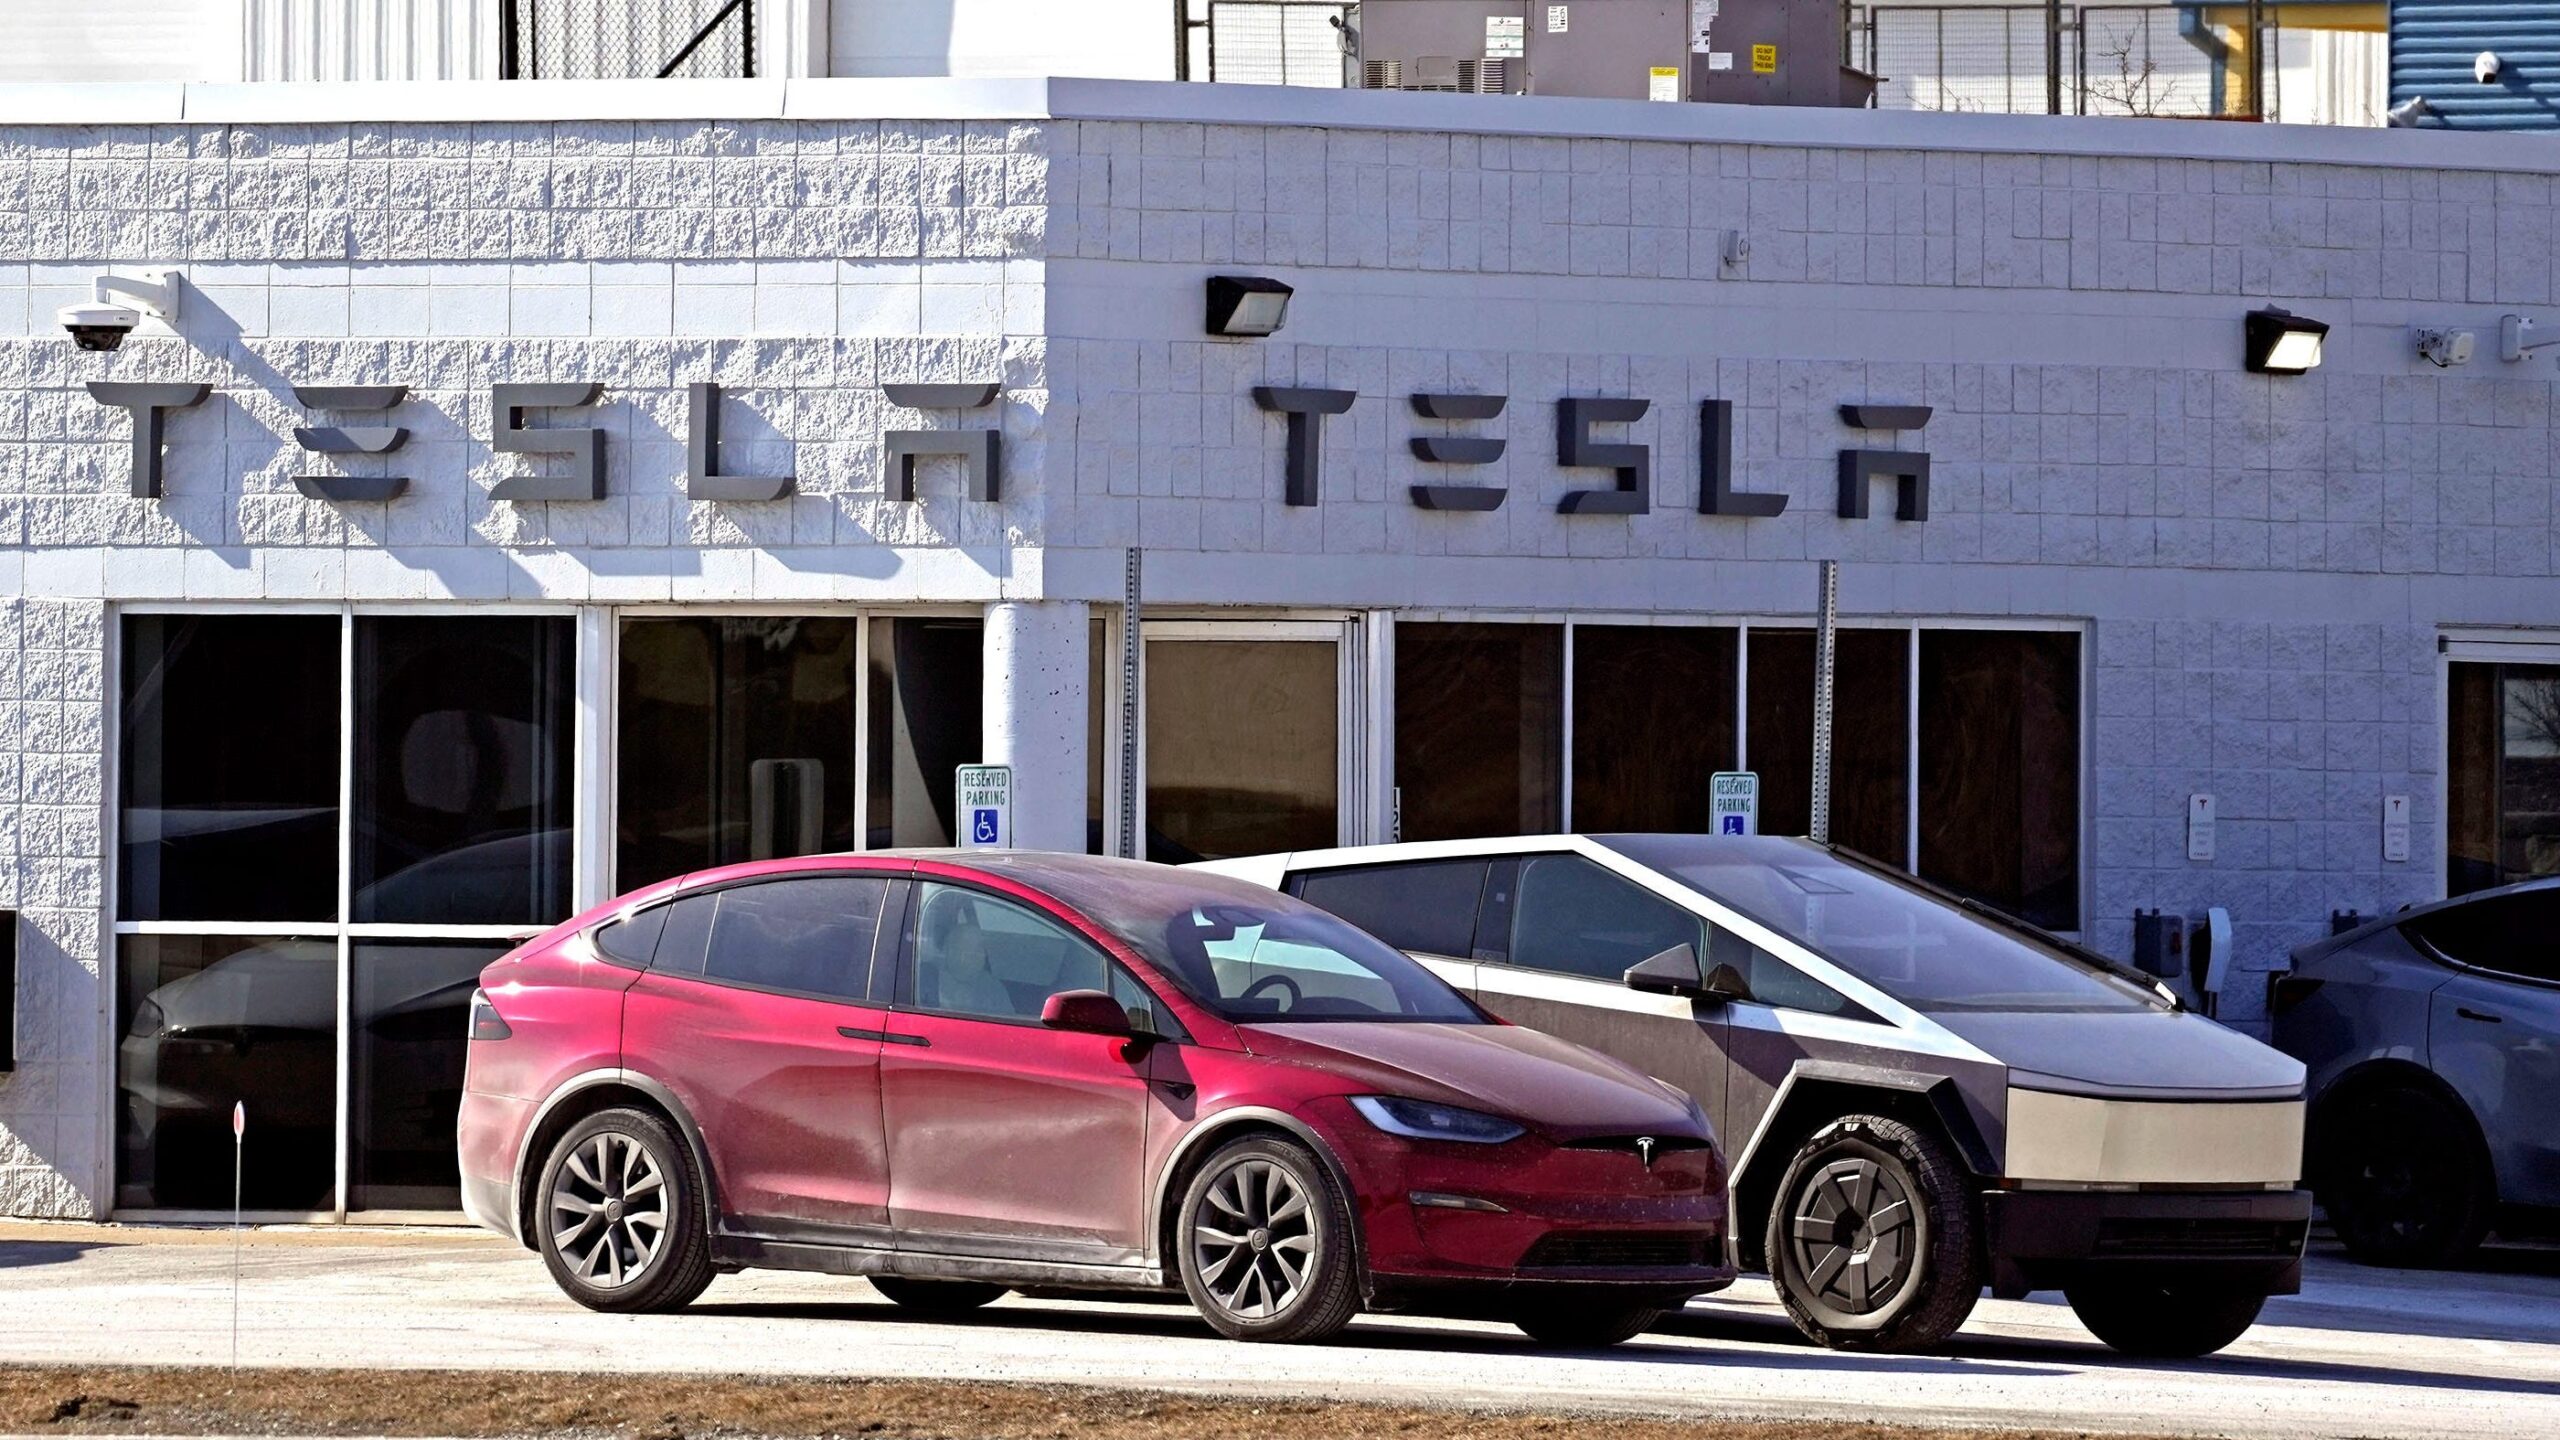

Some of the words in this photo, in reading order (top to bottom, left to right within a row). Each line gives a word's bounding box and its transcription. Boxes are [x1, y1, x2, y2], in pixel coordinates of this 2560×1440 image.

[86, 382, 1000, 503] TESLA
[1252, 386, 1933, 522] TESLA
[964, 772, 1007, 787] RESERVED
[1716, 780, 1753, 795] RESERVED
[966, 791, 1006, 806] PARKING
[1717, 798, 1751, 813] PARKING
